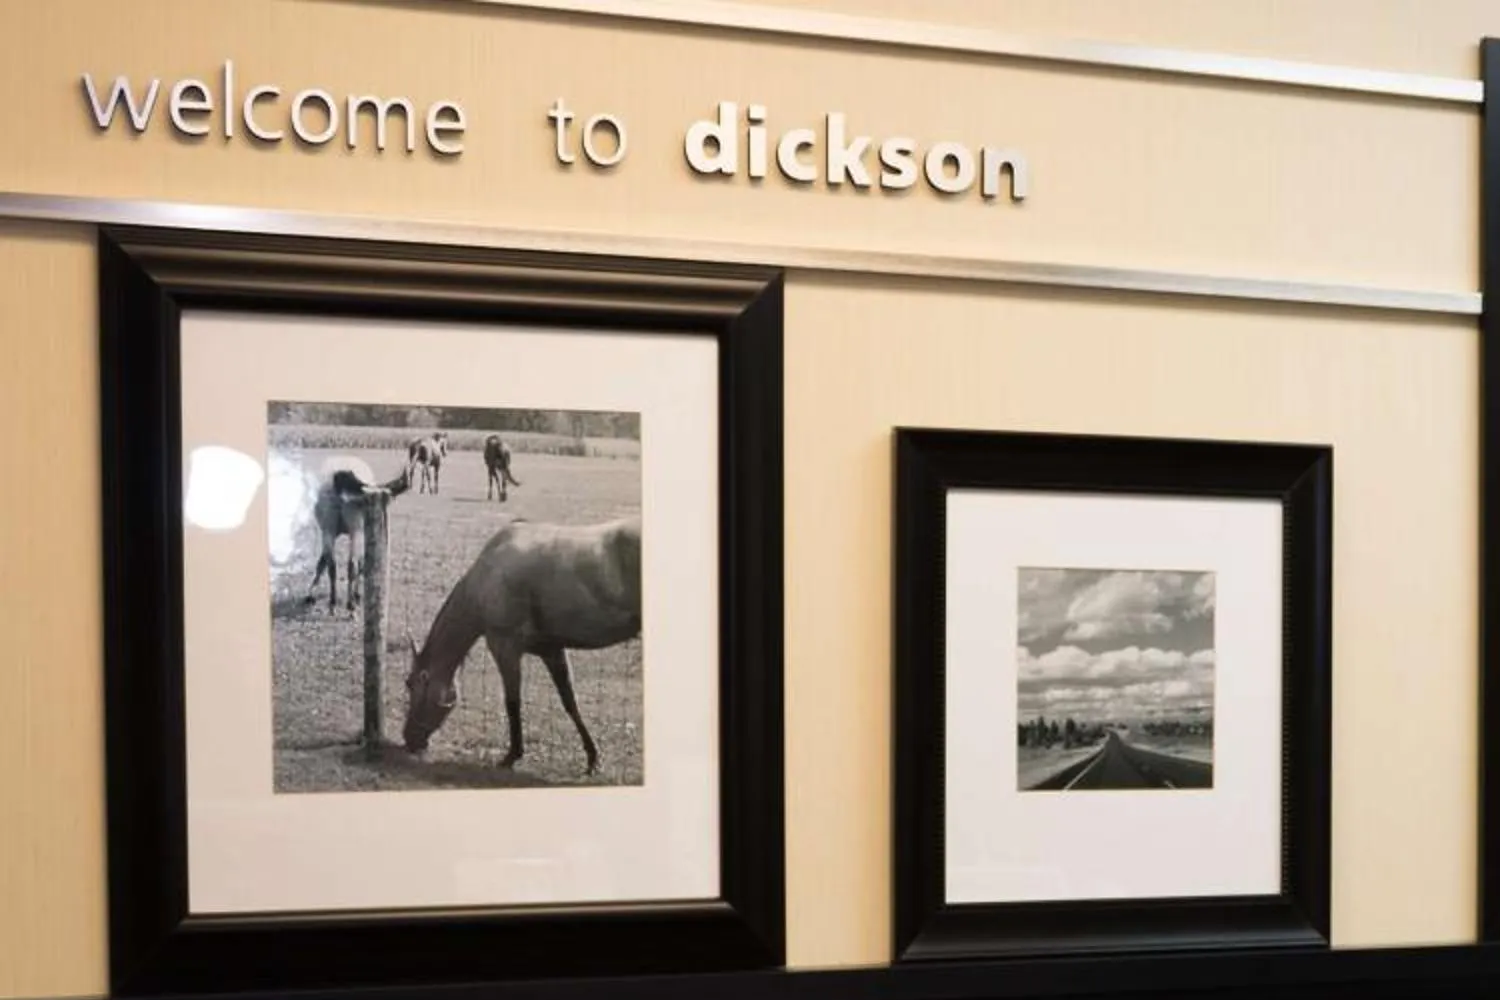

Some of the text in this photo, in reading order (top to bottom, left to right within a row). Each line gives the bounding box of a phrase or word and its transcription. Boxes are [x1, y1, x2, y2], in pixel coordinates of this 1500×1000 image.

[80, 59, 1030, 201] welcome to dickson
